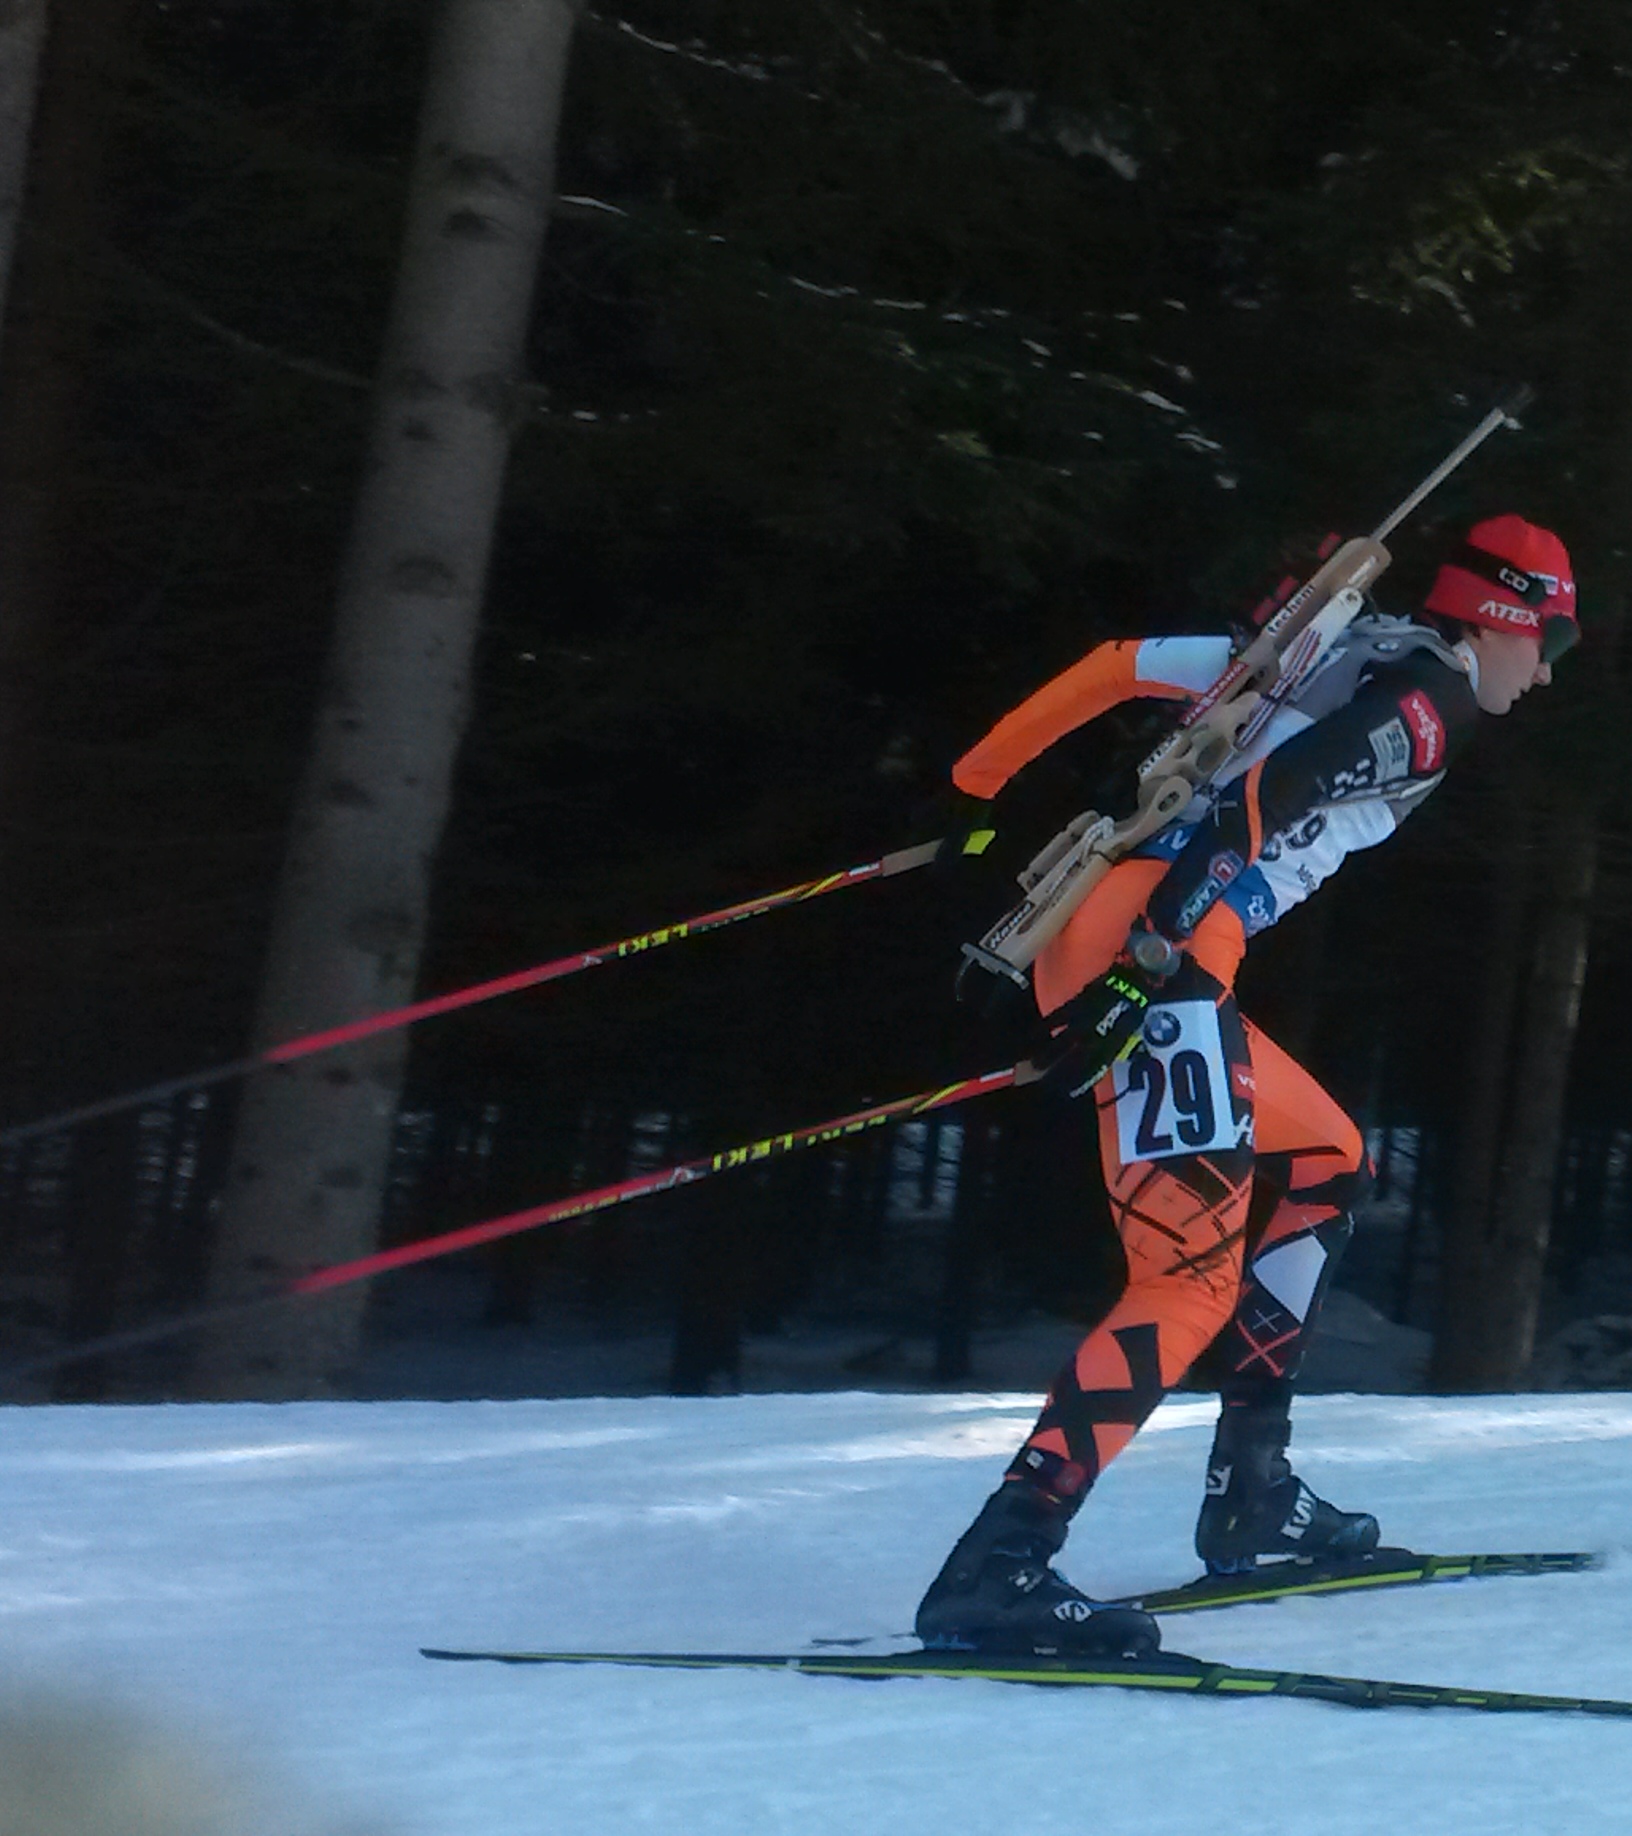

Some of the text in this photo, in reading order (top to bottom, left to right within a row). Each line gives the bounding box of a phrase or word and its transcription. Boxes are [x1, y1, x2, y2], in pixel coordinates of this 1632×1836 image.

[1478, 600, 1541, 628] ATEX
[616, 923, 690, 956] LEKI
[1105, 973, 1150, 1008] LEKI
[1130, 1049, 1217, 1154] 29
[710, 1132, 796, 1172] LEKI
